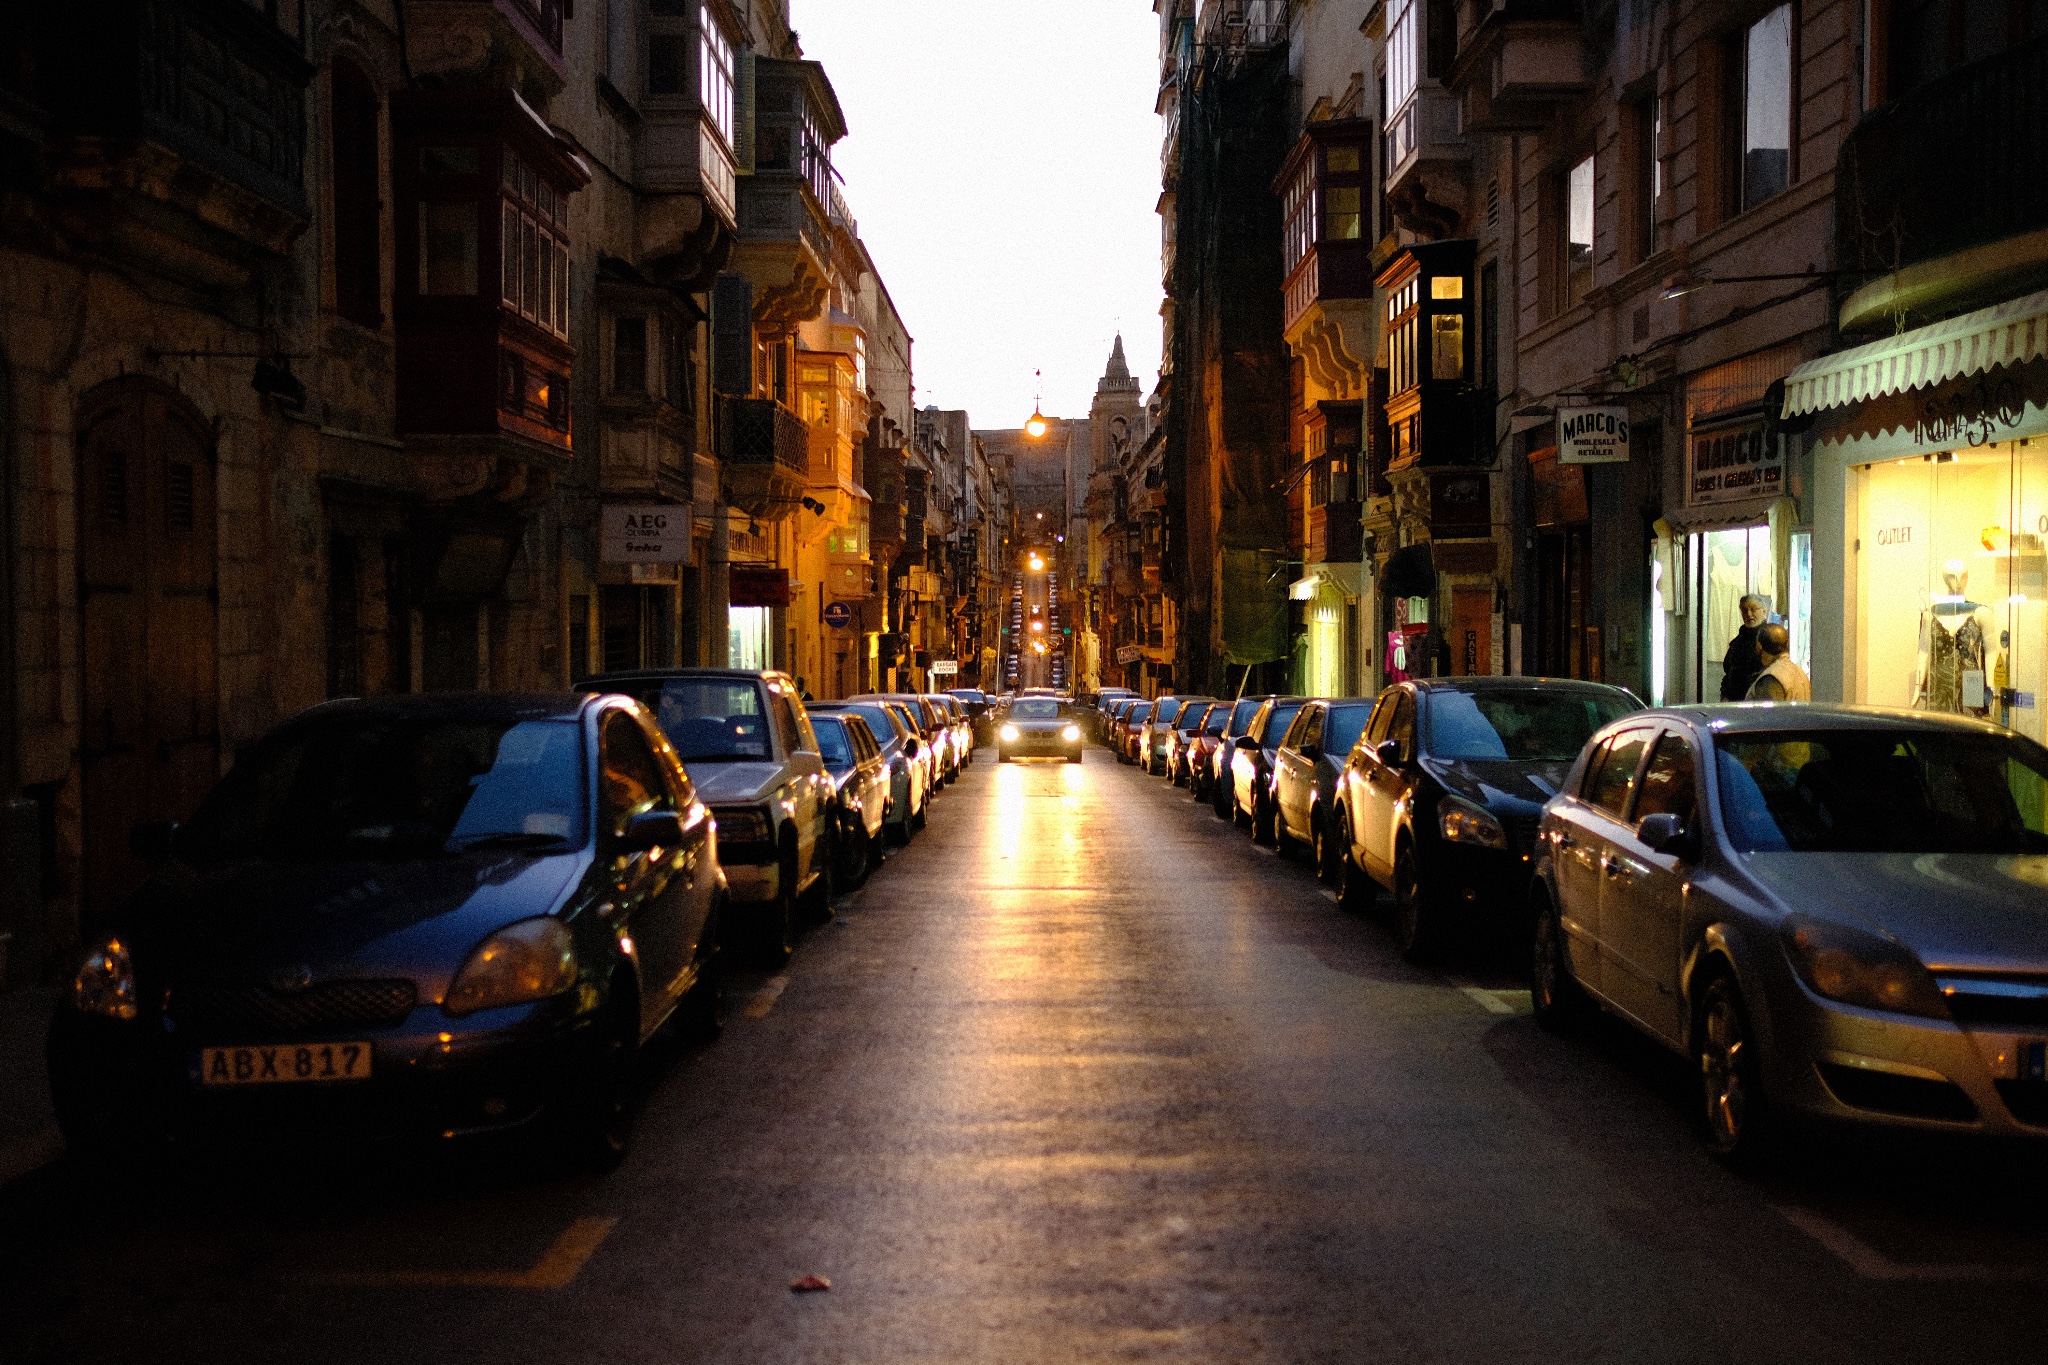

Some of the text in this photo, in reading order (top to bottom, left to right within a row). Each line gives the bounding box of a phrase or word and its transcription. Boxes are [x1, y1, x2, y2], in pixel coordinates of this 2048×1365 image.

[1563, 412, 1628, 444] MARCO'S
[1573, 438, 1616, 446] WHOLESALE
[1578, 448, 1613, 456] RETAILER
[1697, 424, 1780, 471] MARCO'S
[624, 514, 667, 528] AEG
[1877, 526, 1912, 546] OUTLET
[210, 1046, 361, 1080] ABX 817
